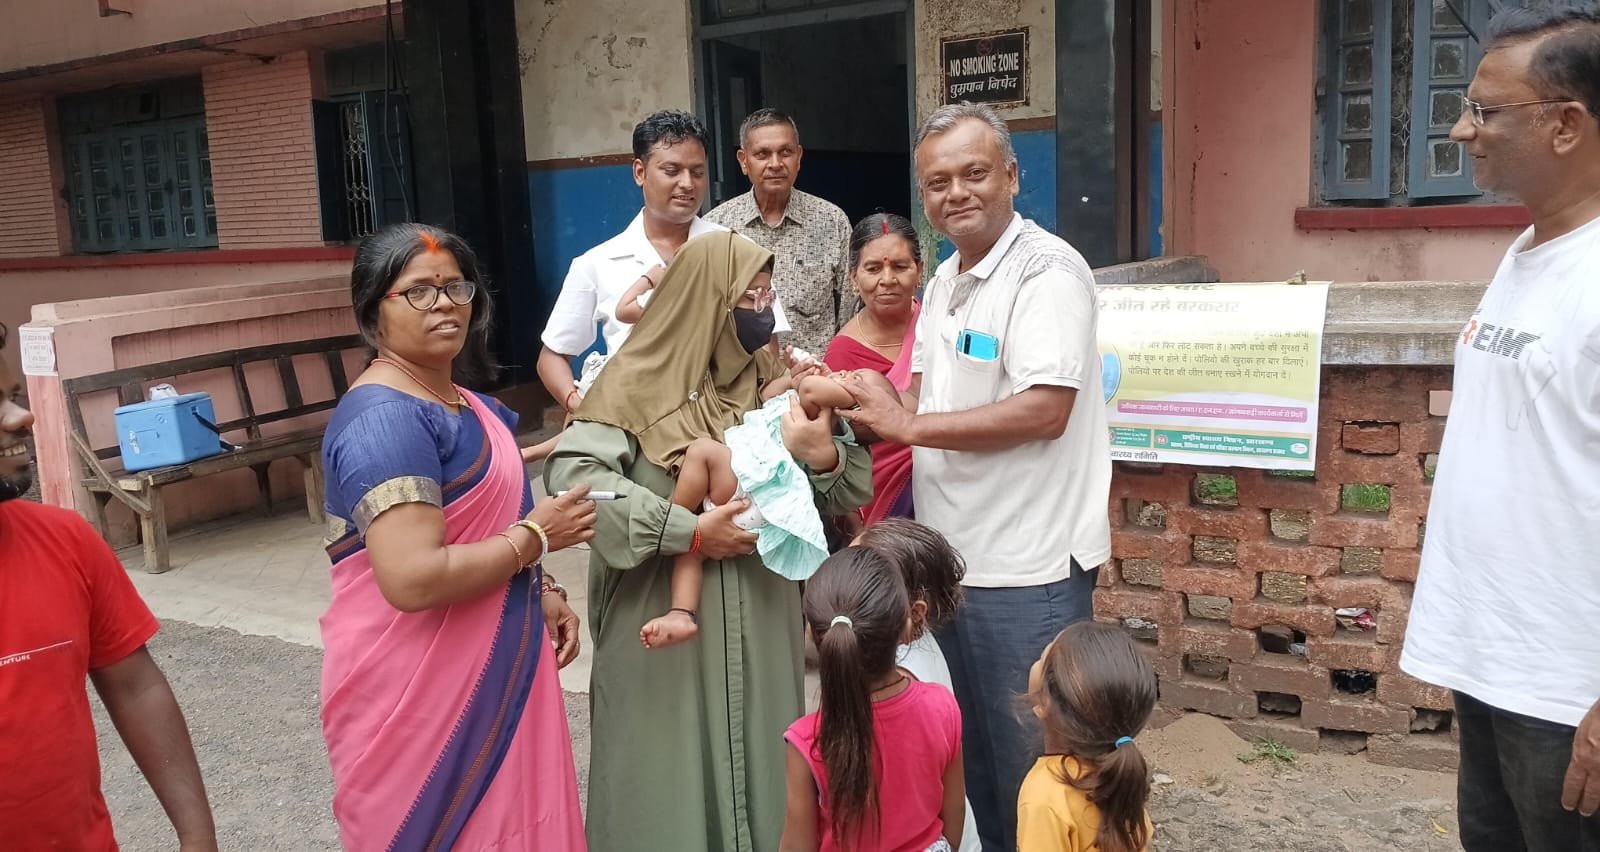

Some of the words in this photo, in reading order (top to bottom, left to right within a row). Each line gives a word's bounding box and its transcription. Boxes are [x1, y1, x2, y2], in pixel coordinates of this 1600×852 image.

[950, 58, 961, 77] NO
[962, 55, 997, 75] SMOKING
[998, 52, 1019, 72] ZONE
[1150, 298, 1171, 312] रहे
